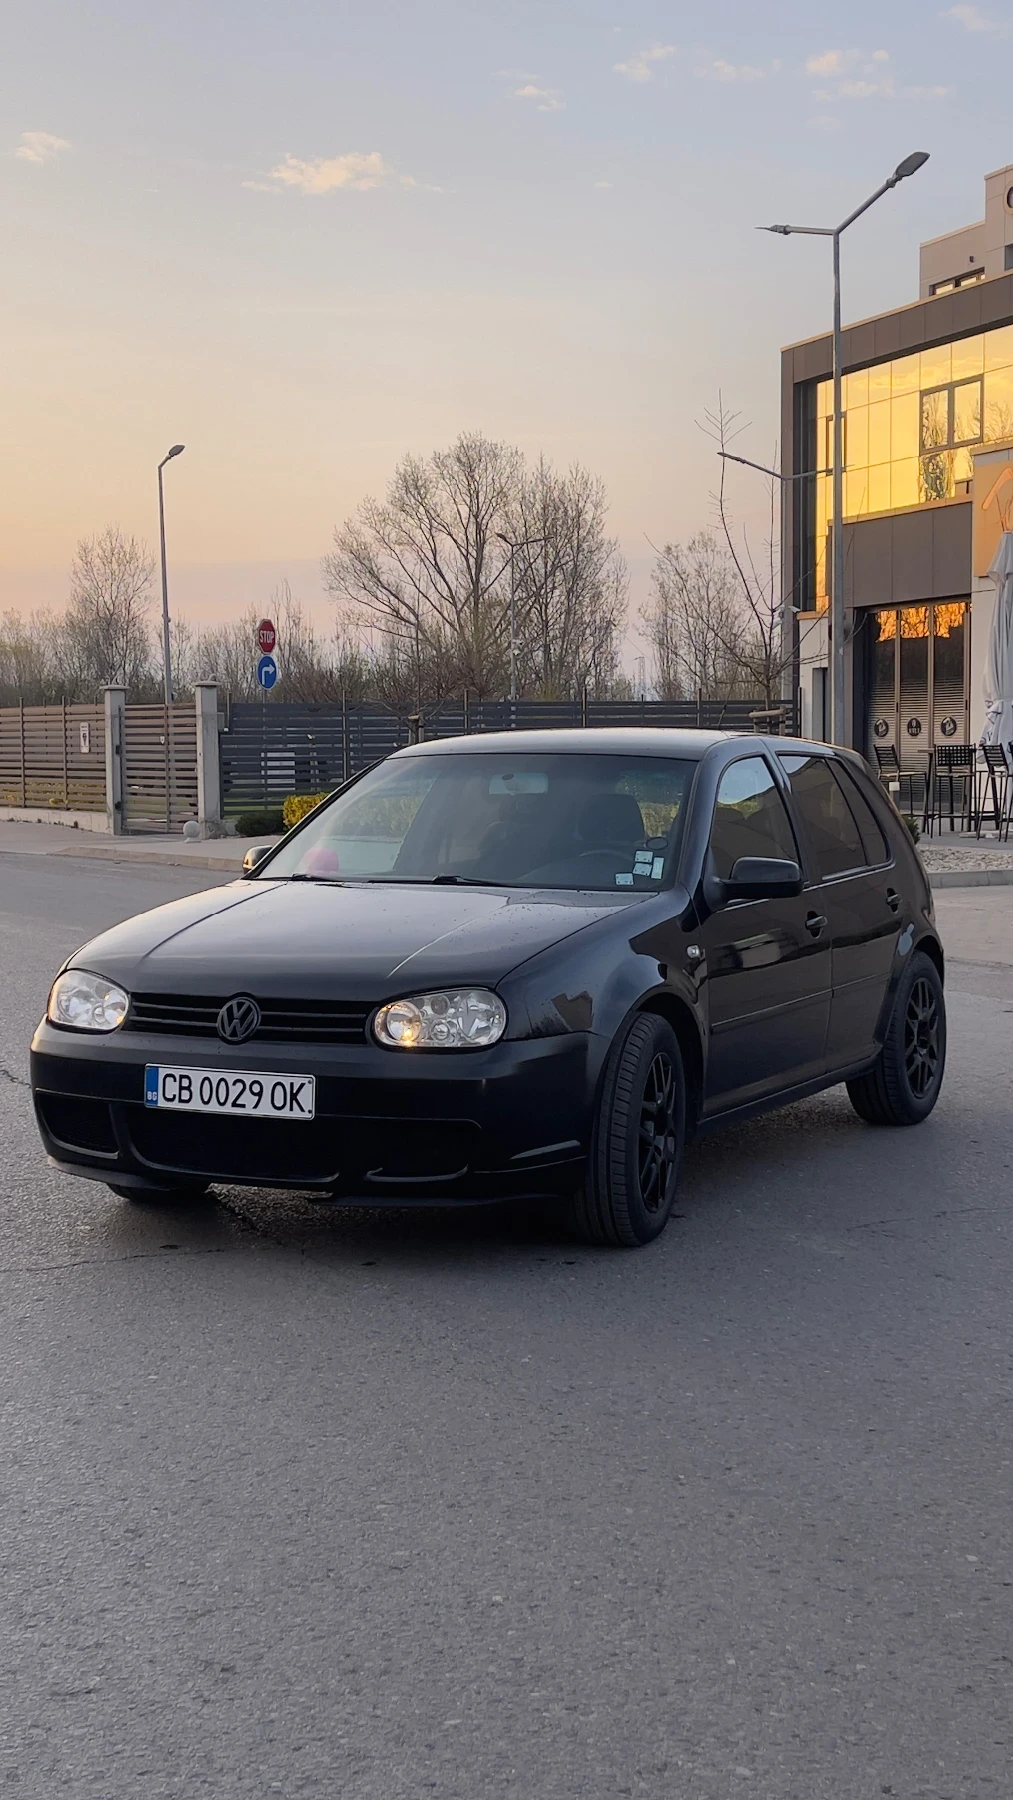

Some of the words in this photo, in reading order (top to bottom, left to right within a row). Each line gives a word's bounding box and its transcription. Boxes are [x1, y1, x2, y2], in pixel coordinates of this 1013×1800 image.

[259, 630, 275, 644] STOP
[147, 1090, 158, 1101] BG
[162, 1072, 193, 1104] CB
[199, 1076, 264, 1110] 0029
[270, 1080, 307, 1113] OK
